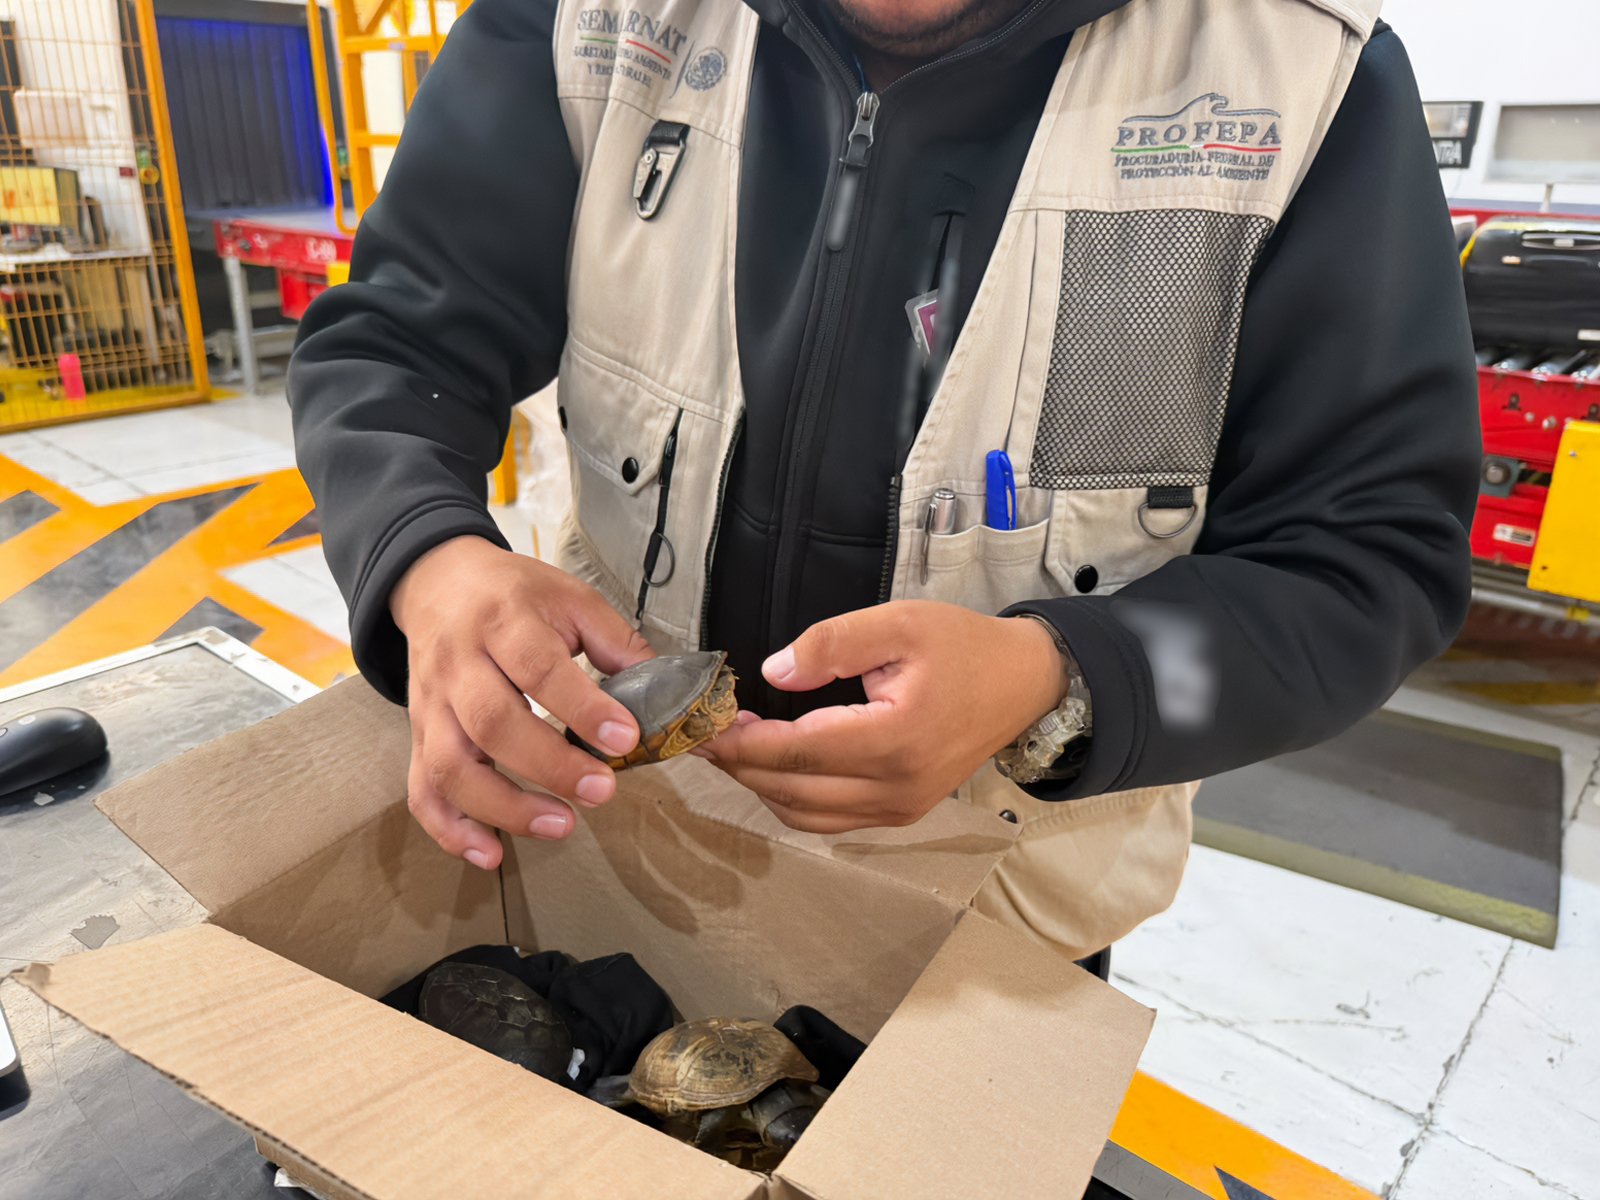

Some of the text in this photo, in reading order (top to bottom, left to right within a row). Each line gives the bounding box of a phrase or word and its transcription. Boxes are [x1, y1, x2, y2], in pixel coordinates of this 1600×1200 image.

[577, 9, 687, 56] SEMRNAT
[1116, 121, 1281, 146] PROFEPA
[1207, 151, 1255, 167] FEDERAL
[1258, 154, 1275, 167] DE
[1197, 165, 1215, 176] AL
